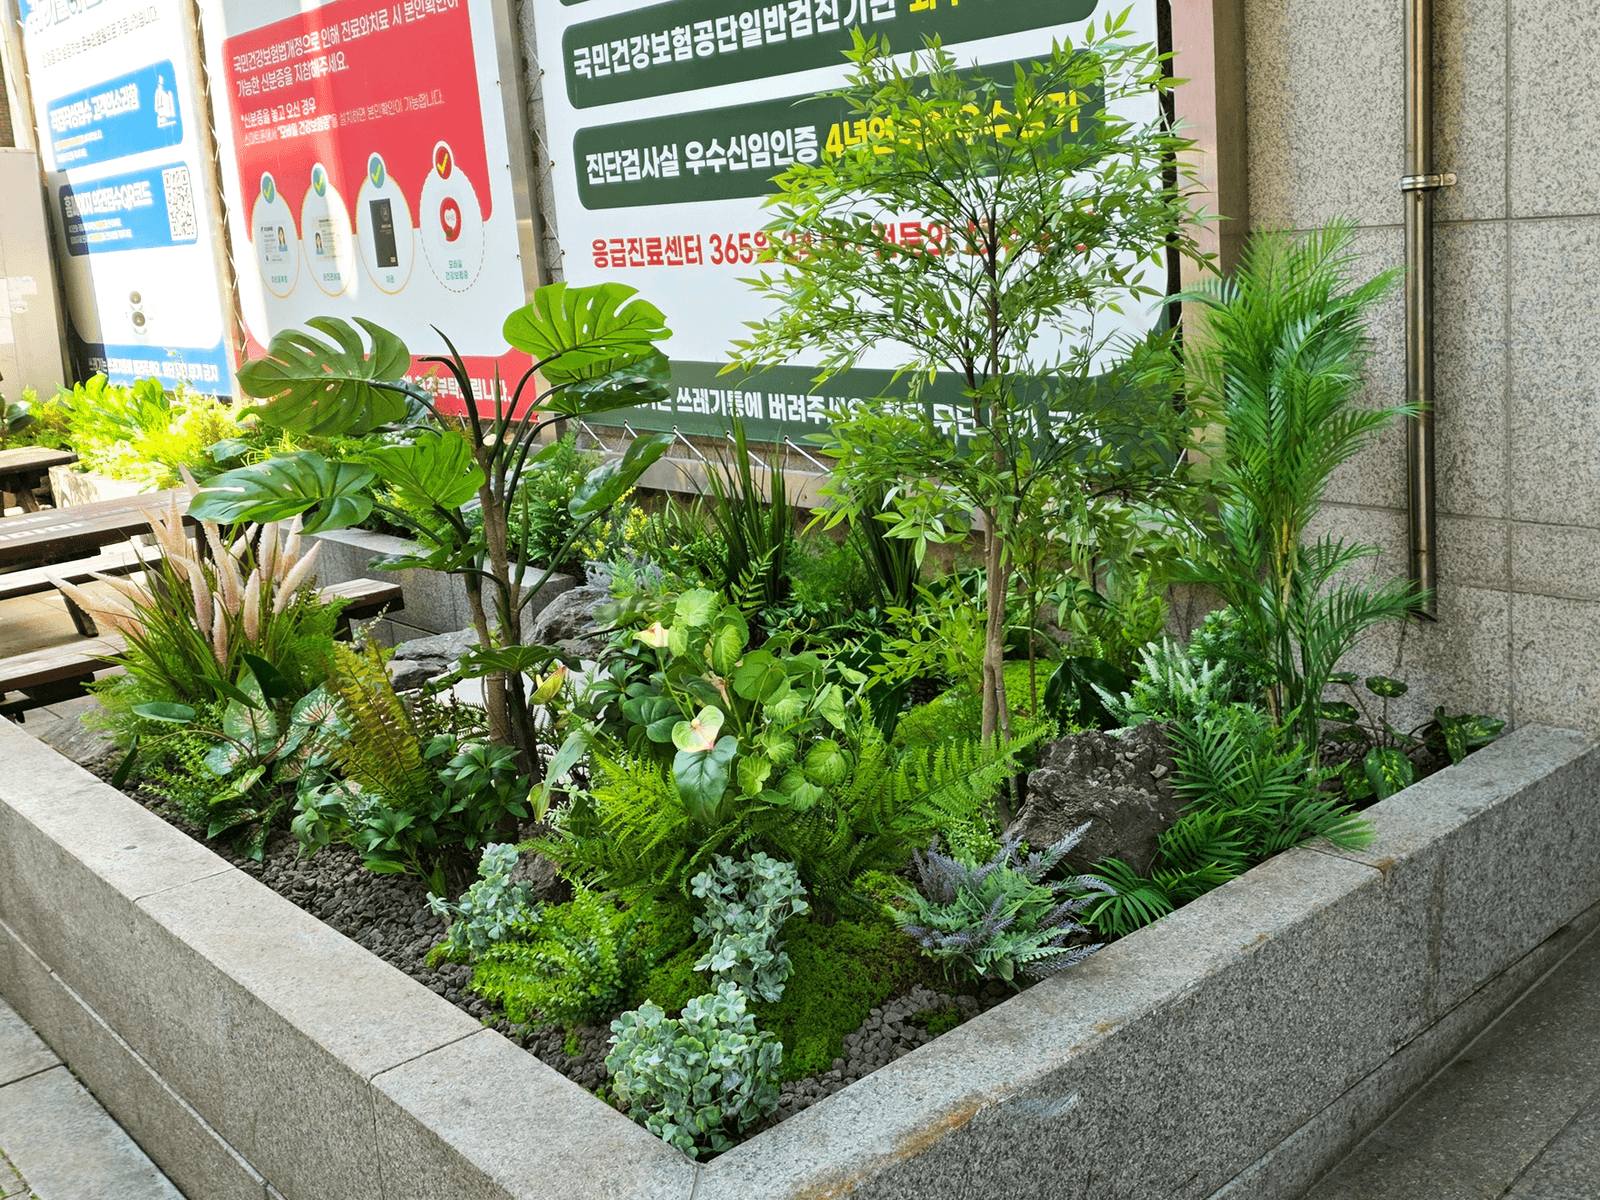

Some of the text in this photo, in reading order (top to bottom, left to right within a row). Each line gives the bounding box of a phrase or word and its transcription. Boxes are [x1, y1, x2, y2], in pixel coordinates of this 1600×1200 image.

[321, 23, 340, 49] 인해
[392, 3, 402, 26] 시
[236, 51, 349, 97] 가능한 신분증을 지참해주세요.
[271, 105, 286, 123] 놓고
[286, 101, 301, 119] 오신
[301, 97, 316, 116] 경우
[339, 107, 366, 127] 설치하면
[366, 98, 403, 120] 본인확인이
[403, 88, 445, 111] 가능합니다.
[586, 142, 680, 185] 진단검사실
[685, 125, 818, 173] 우수신임인증
[592, 234, 703, 268] 응급진료센터
[676, 386, 763, 419] 쓰레기통에
